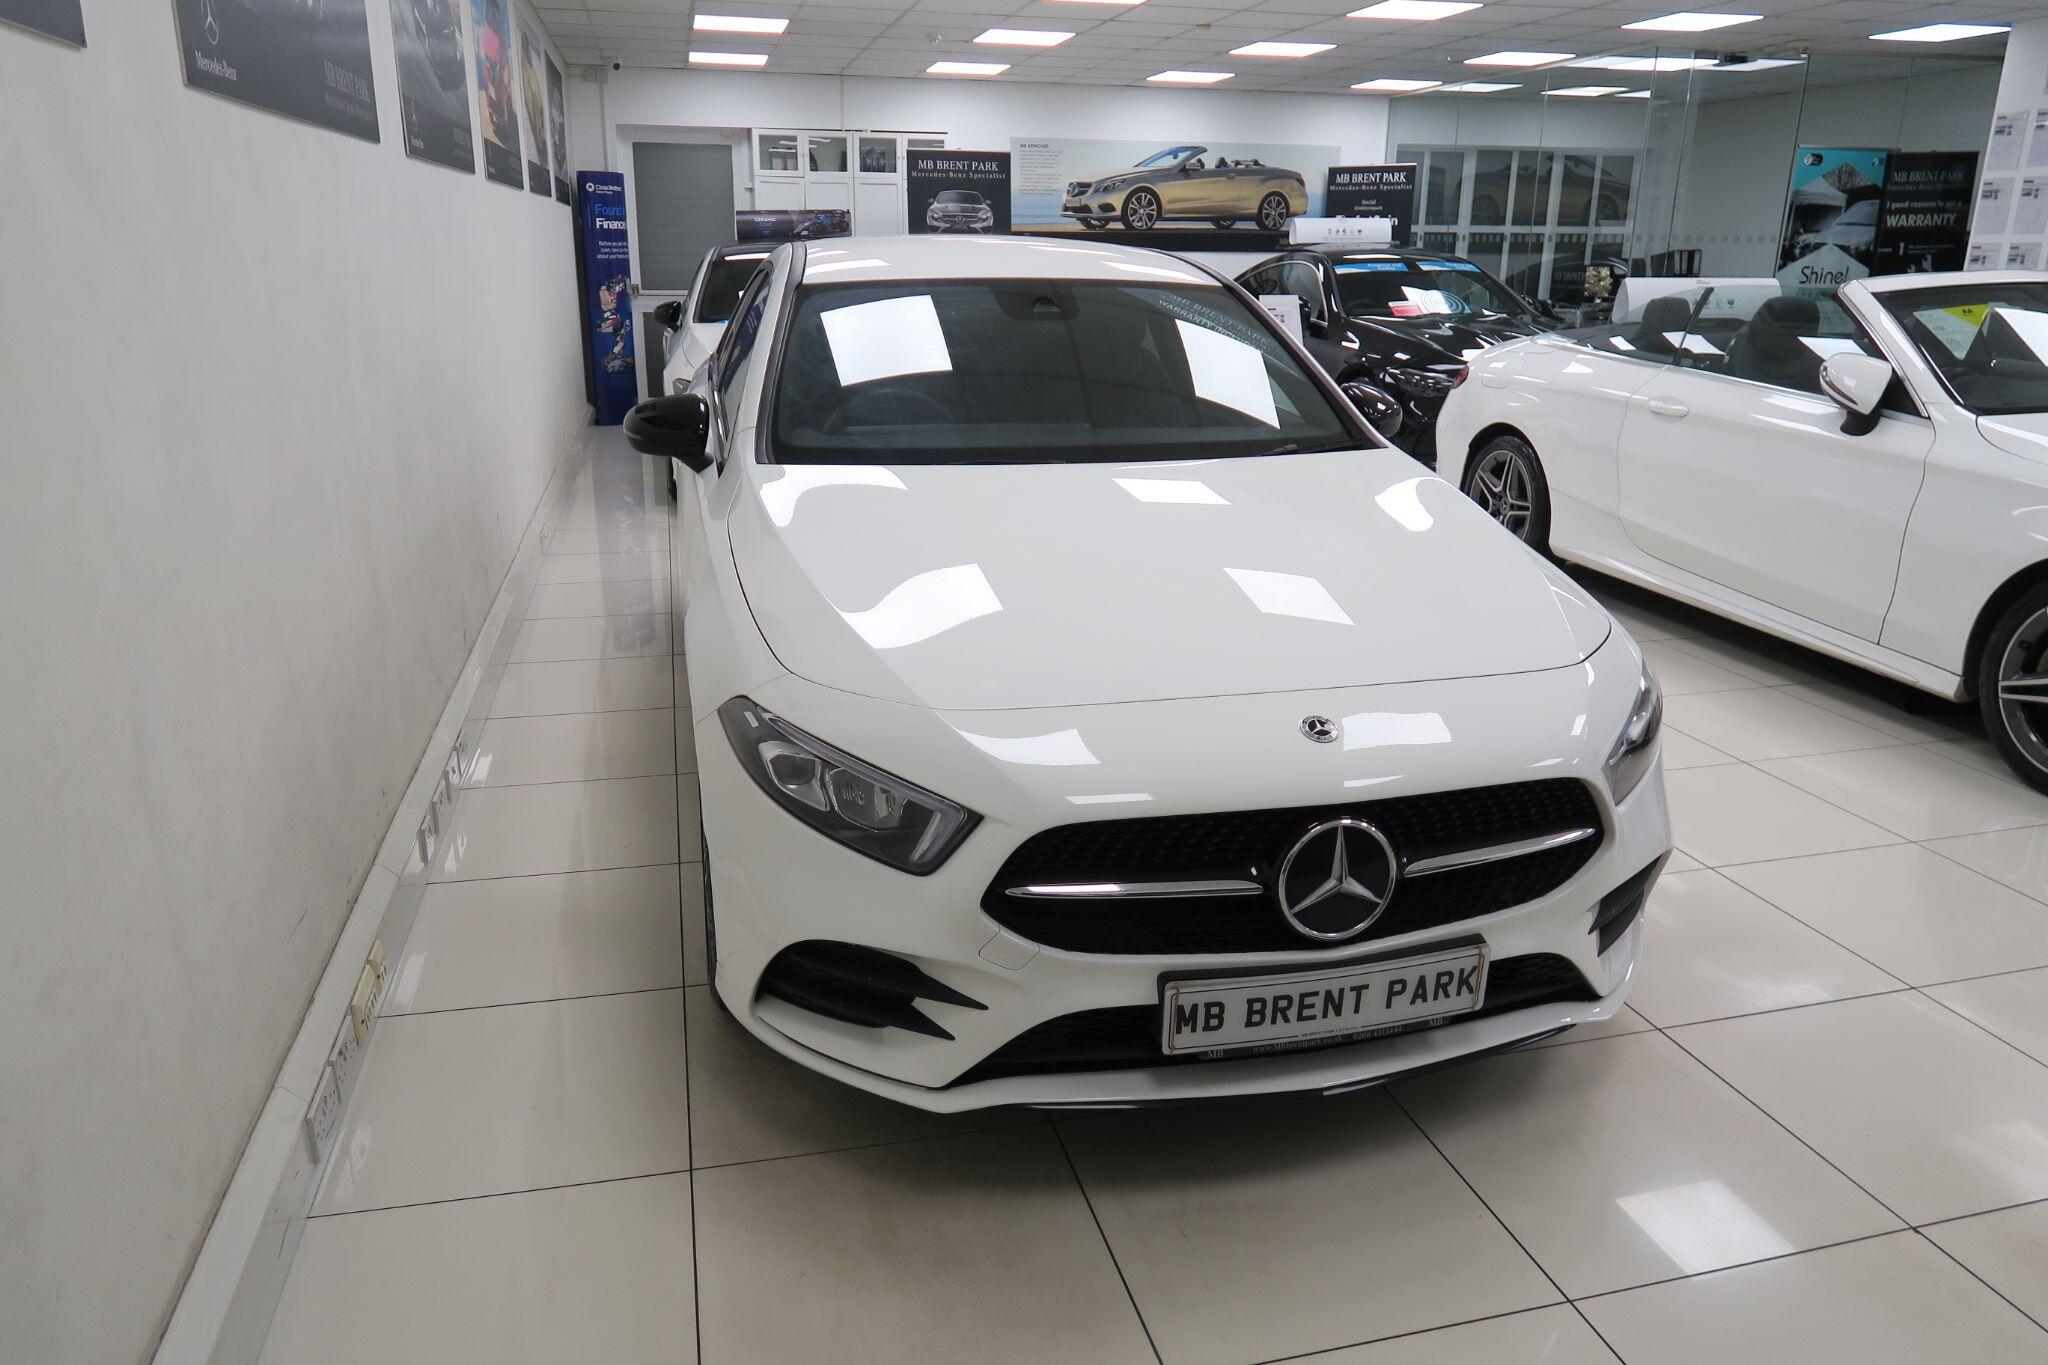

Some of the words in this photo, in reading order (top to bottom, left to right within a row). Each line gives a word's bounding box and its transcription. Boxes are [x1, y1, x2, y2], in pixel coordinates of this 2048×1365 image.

[194, 50, 237, 80] Mercedes-Benz
[918, 160, 934, 170] MB
[937, 160, 970, 170] BRENT
[972, 161, 999, 171] PARK
[911, 170, 967, 178] Mercedes-Benz
[969, 172, 1006, 180] Specialist
[1335, 173, 1350, 184] MB
[1351, 173, 1381, 184] BRENT
[1383, 172, 1407, 183] PARK
[1893, 171, 1908, 183] MB
[1909, 170, 1938, 183] BRENT
[1940, 170, 1966, 183] PARK
[1379, 183, 1413, 191] Specialist
[1891, 200, 1910, 210] good
[1910, 200, 1936, 209] reasons
[1886, 213, 1957, 228] WARRANTY
[1799, 265, 1850, 285] Shine!
[1159, 300, 1213, 328] WARRANTY
[1175, 1001, 1225, 1035] MB
[1244, 984, 1369, 1028] BRENT
[1385, 965, 1478, 1010] PARK
